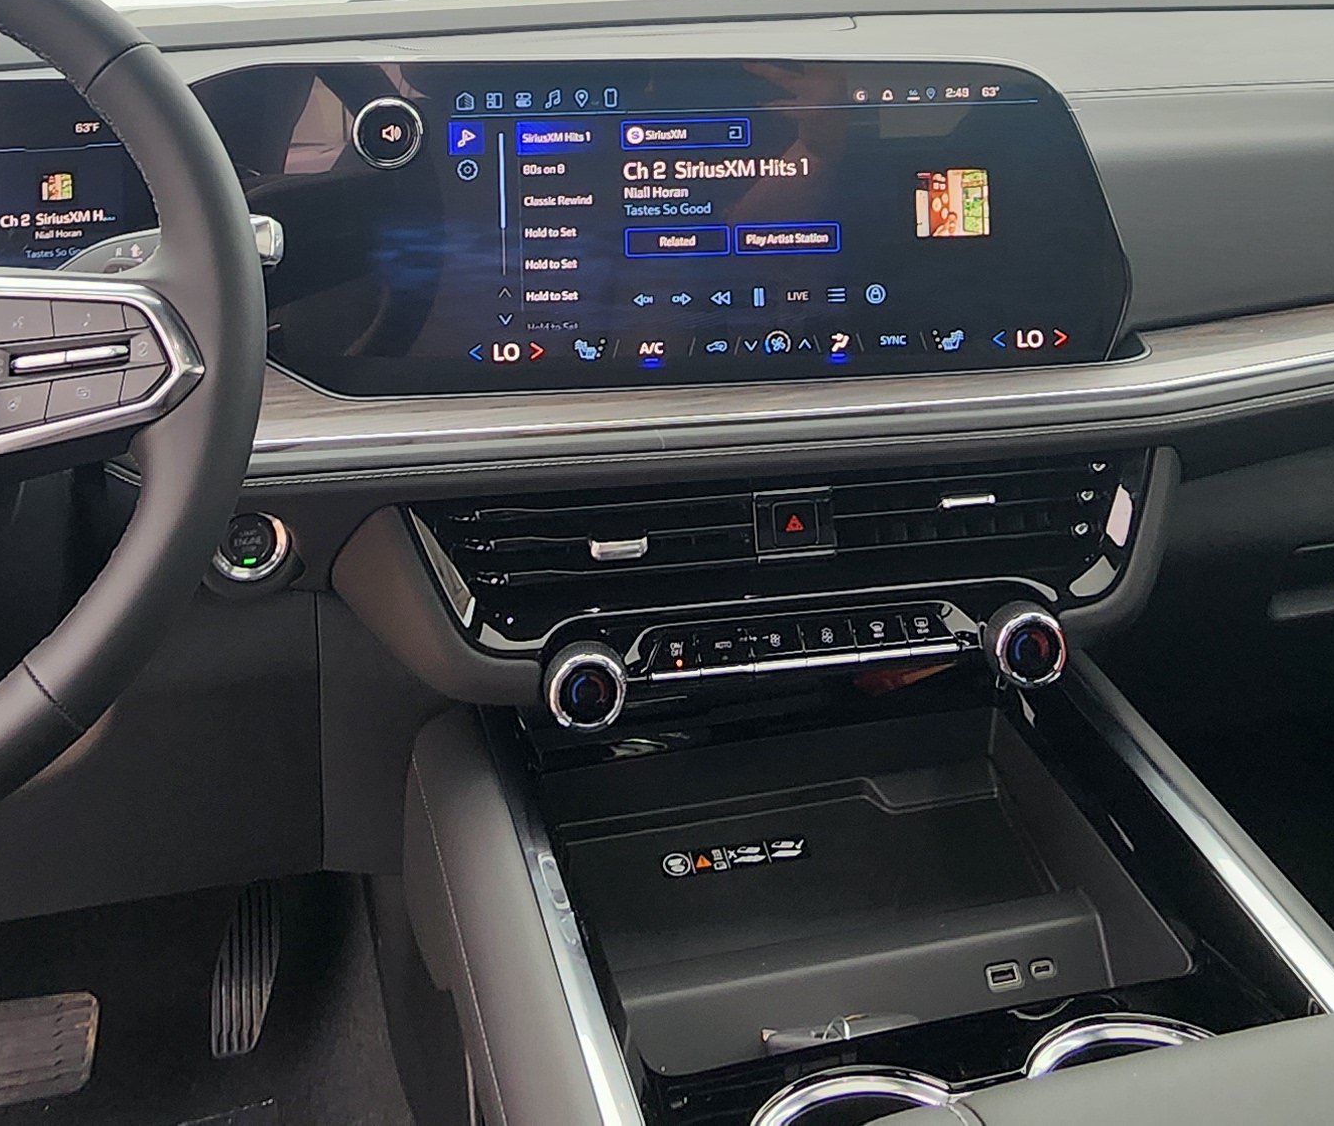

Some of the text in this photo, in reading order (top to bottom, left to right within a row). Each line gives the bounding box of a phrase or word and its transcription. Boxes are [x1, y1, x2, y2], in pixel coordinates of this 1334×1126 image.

[945, 87, 969, 99] 2:49
[521, 131, 591, 144] SiriusXM Hits 1
[645, 129, 687, 141] SiriusXM
[523, 163, 542, 175] 80s
[543, 166, 556, 174] on
[623, 158, 808, 181] Ch 2 SiriusXM Hits 1
[623, 185, 689, 199] Niall Horan
[524, 194, 592, 207] Classic Rewind
[623, 202, 711, 217] Tastes So Good
[0, 214, 18, 228] Ch
[20, 214, 31, 226] 2
[35, 210, 91, 226] SiriusXM
[35, 229, 82, 239] Niall Horan
[524, 227, 576, 239] Hold to Set
[745, 232, 828, 247] Play Artist Station
[659, 235, 696, 247] Related
[25, 248, 66, 259] Tastes So
[525, 258, 578, 270] Hold to Set
[525, 290, 578, 302] Hold to Set
[787, 290, 809, 302] LIVE
[879, 333, 906, 346] SYNC
[1016, 331, 1043, 348] LO
[493, 343, 520, 362] LO
[639, 340, 664, 356] A/C
